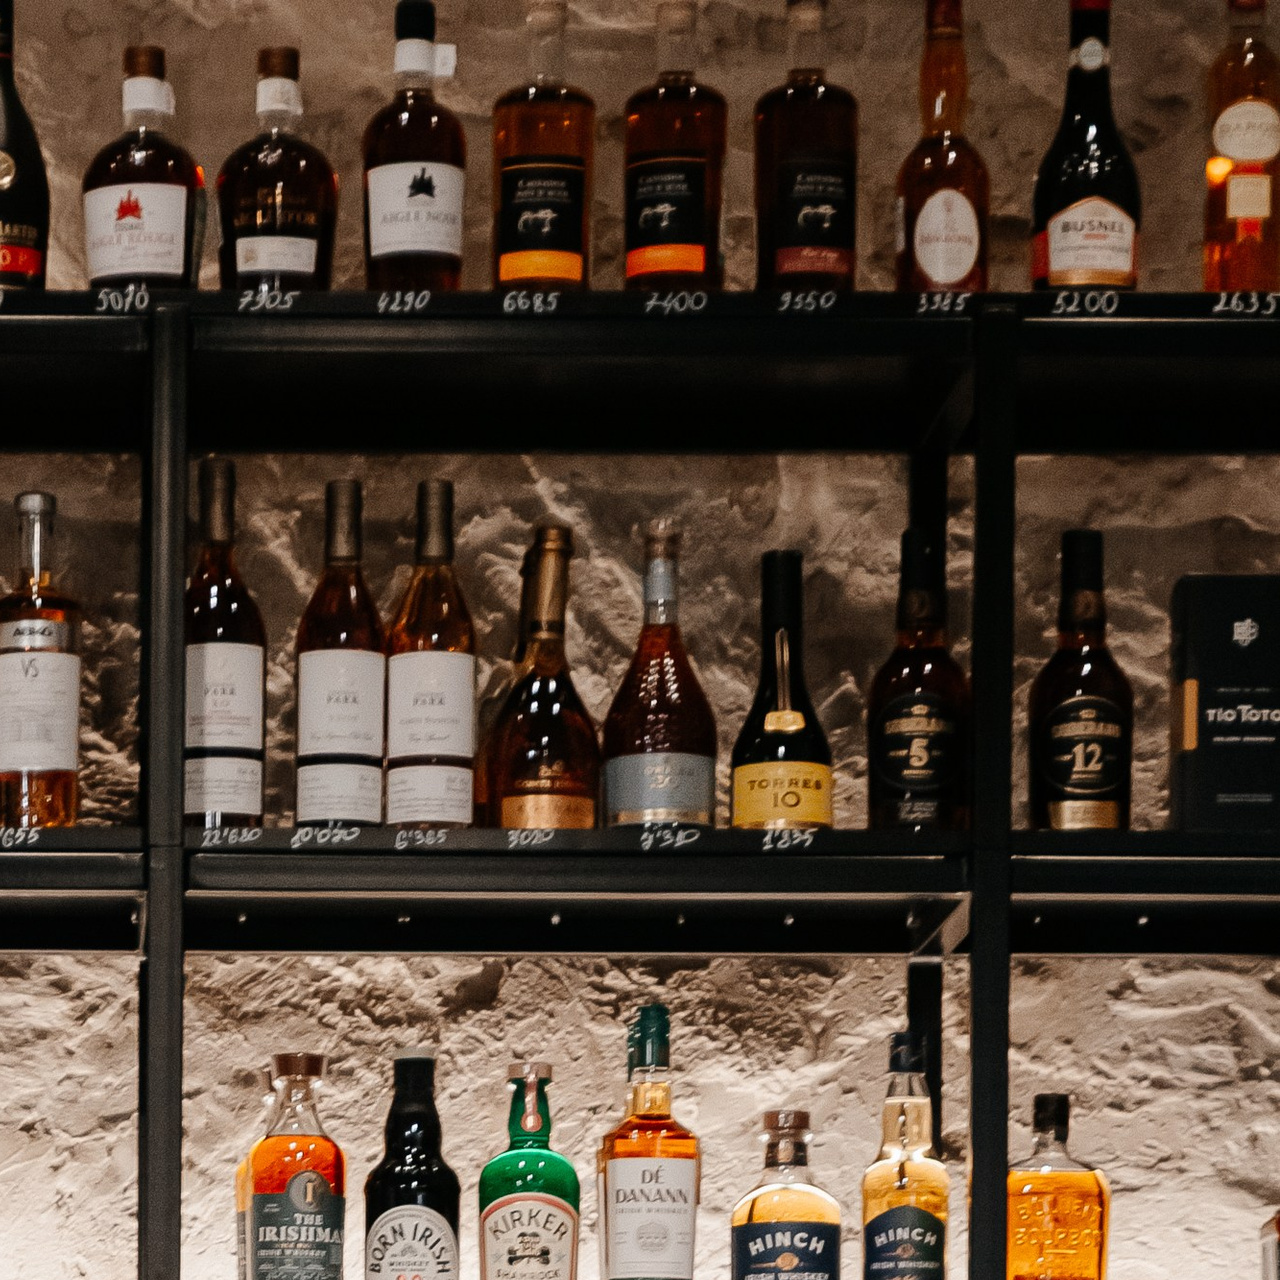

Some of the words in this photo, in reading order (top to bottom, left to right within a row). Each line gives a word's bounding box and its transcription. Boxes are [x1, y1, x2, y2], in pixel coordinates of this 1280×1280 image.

[503, 291, 561, 311] 6685
[1052, 291, 1119, 314] 5200
[1212, 292, 1279, 313] 2635
[908, 738, 930, 768] 5
[1072, 742, 1104, 773] 12
[746, 778, 823, 792] TORRES
[771, 791, 802, 809] 10
[640, 1165, 664, 1185] DÉ
[614, 1187, 689, 1205] DANANN
[293, 1212, 324, 1226] THE
[488, 1207, 570, 1242] KIRKER
[258, 1226, 344, 1243] IRISHMA
[748, 1230, 826, 1257] HINCH
[873, 1226, 938, 1248] HINCH
[369, 1222, 406, 1273] BORN
[412, 1222, 452, 1273] IRISH
